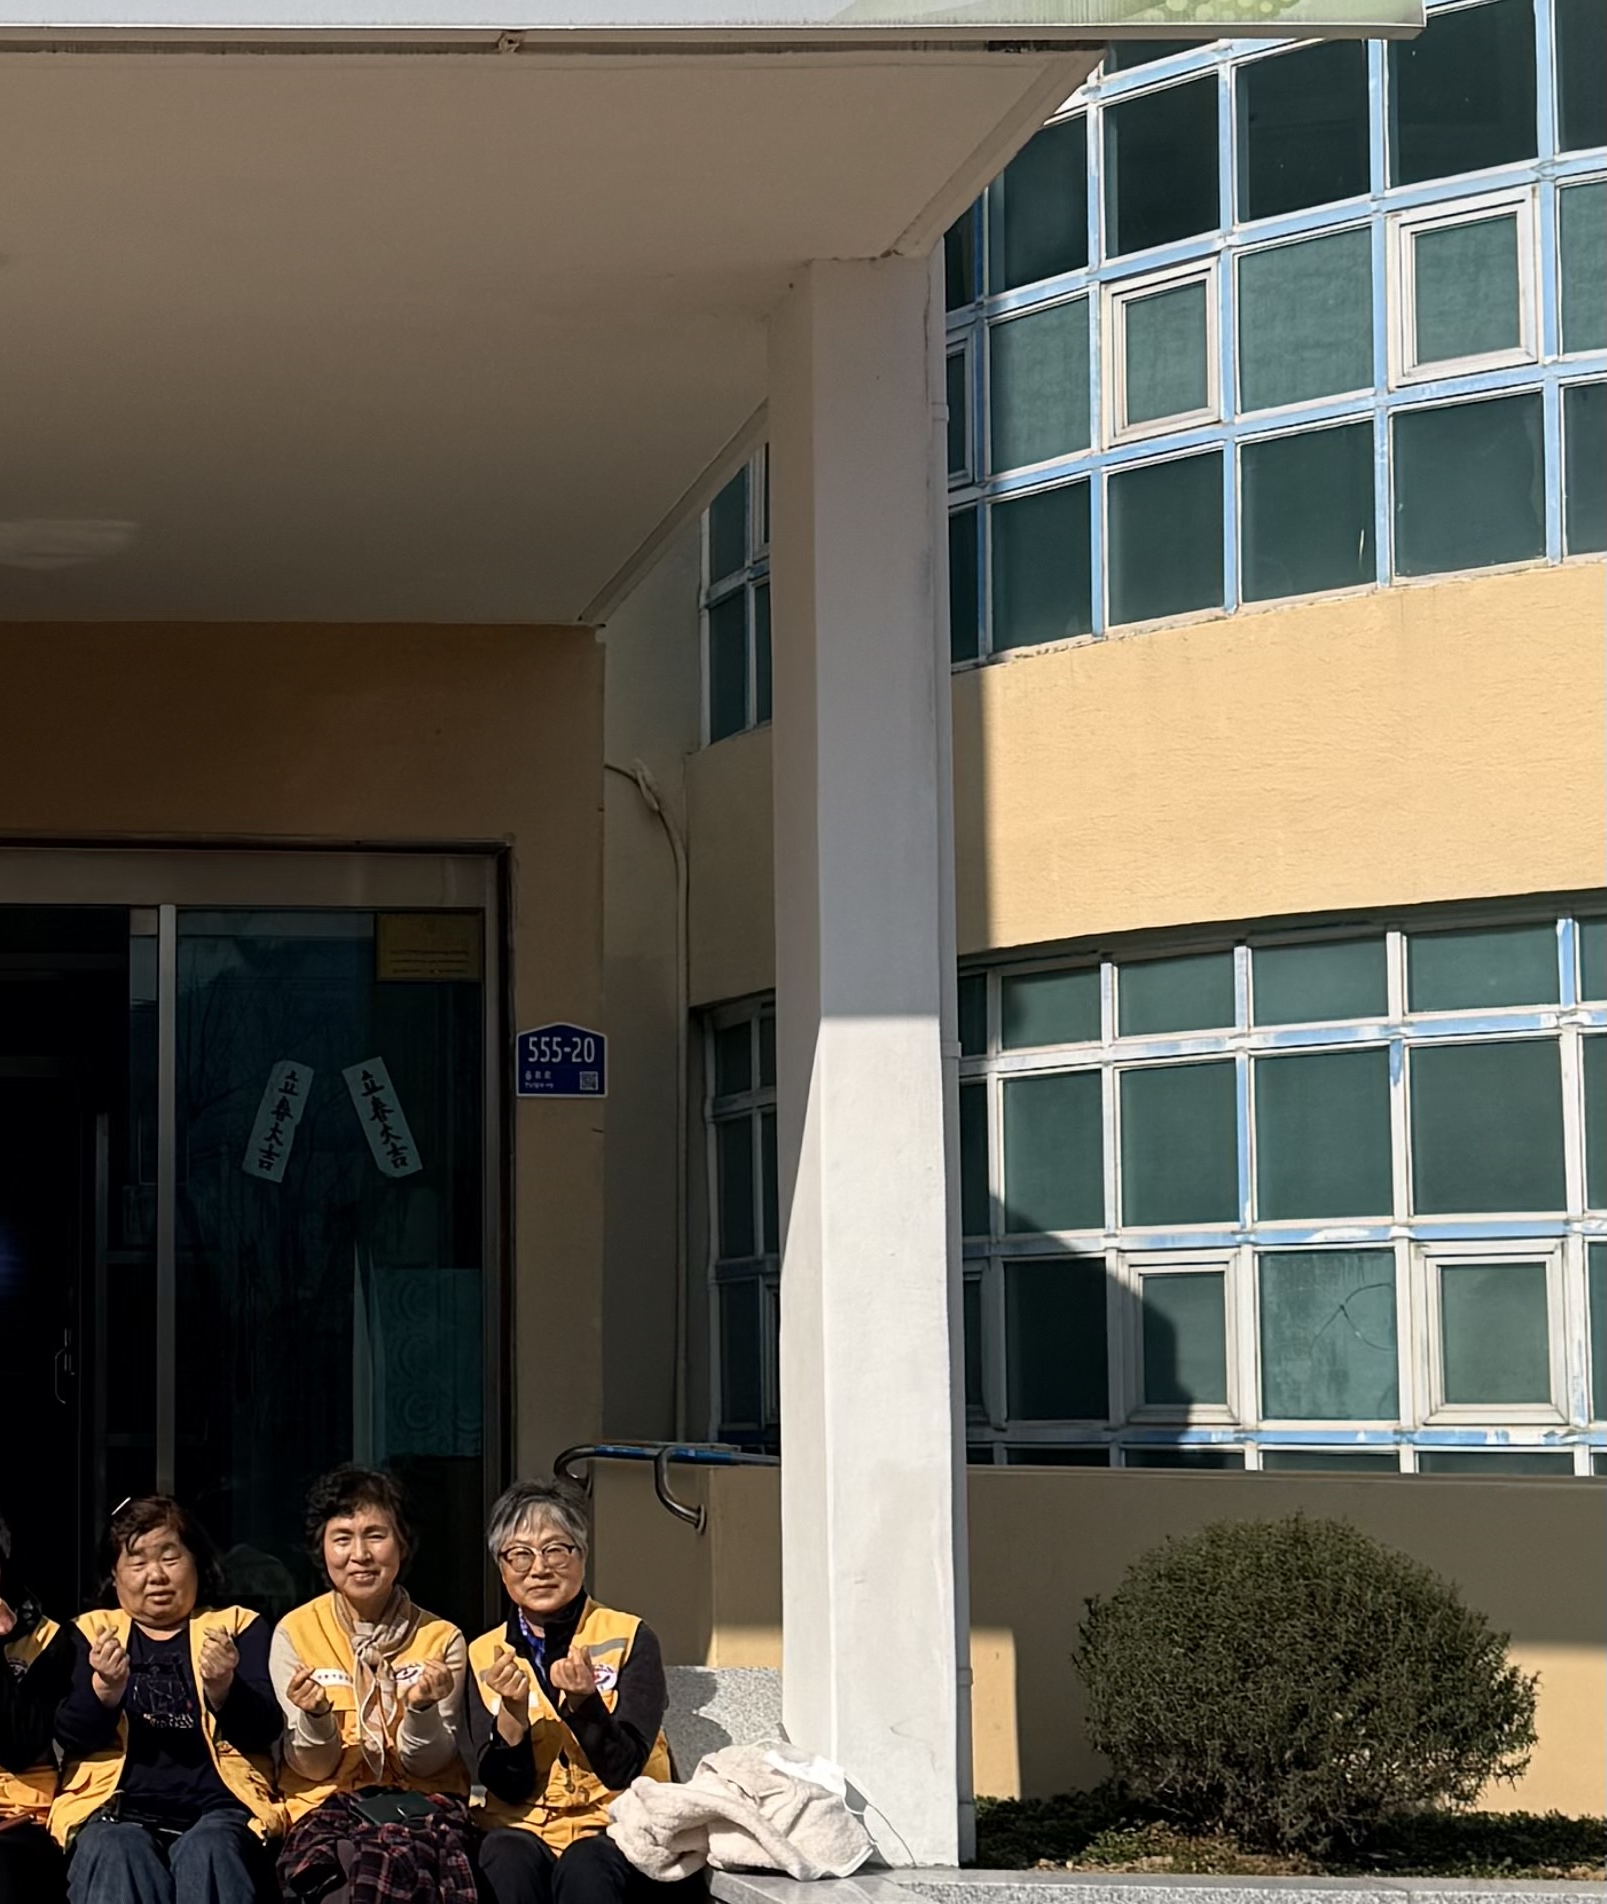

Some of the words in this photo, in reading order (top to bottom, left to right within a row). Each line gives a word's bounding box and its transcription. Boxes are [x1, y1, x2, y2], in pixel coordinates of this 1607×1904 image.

[527, 1036, 596, 1063] 555-20
[258, 1069, 299, 1172] 立春大吉
[360, 1069, 409, 1169] 立春大吉
